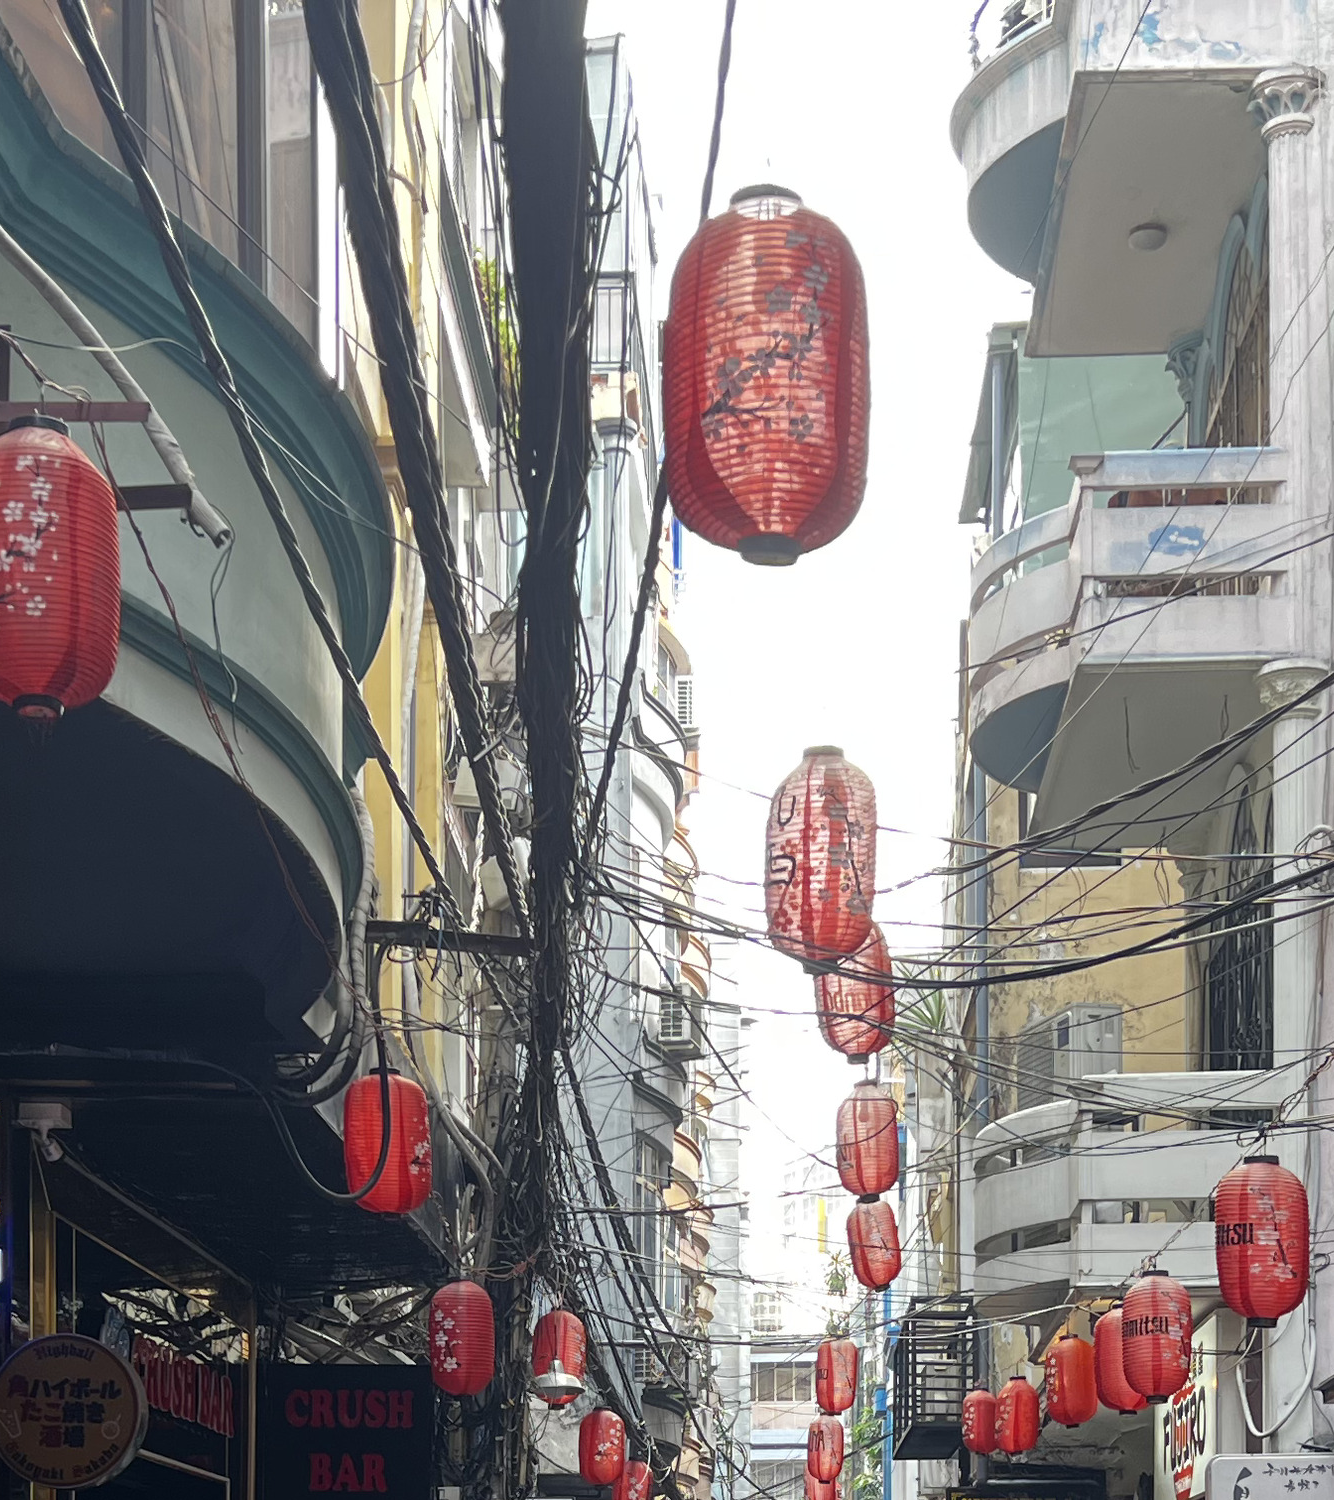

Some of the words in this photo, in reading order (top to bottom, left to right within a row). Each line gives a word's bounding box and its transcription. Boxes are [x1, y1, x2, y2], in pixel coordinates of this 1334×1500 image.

[197, 1364, 235, 1439] BAR
[284, 1388, 414, 1429] CRUSH
[308, 1453, 388, 1493] BAR
